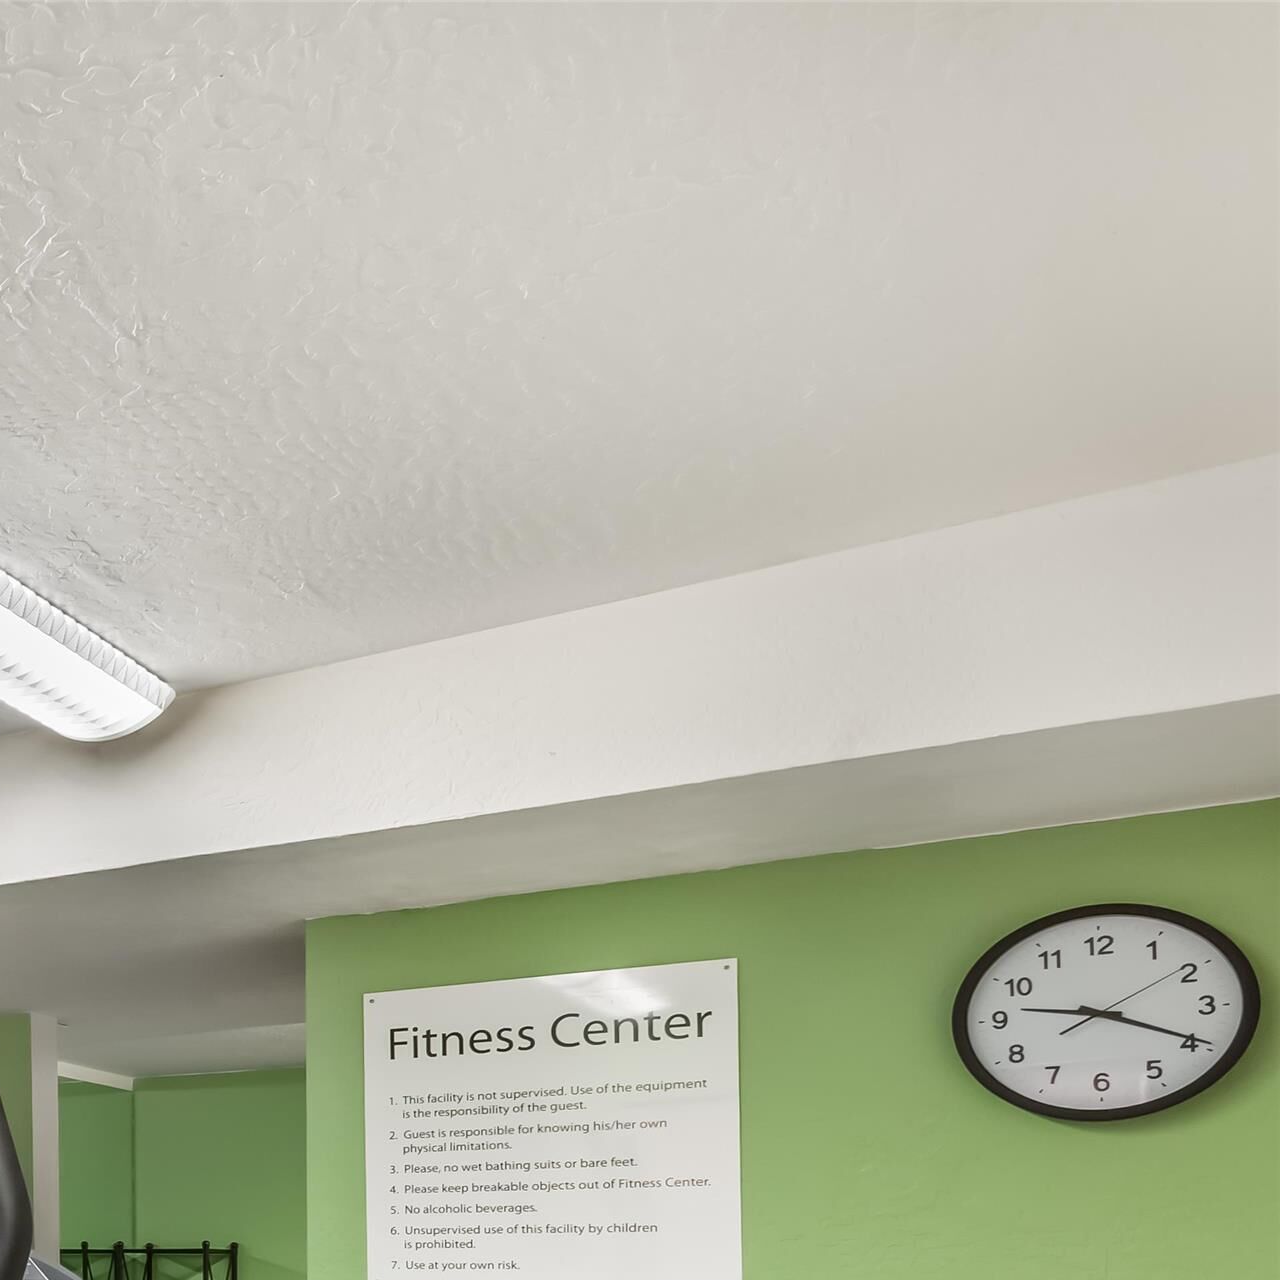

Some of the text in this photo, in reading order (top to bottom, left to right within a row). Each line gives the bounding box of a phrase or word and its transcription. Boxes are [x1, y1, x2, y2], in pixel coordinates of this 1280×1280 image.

[1083, 935, 1114, 956] 12
[1146, 940, 1157, 960] 1
[1038, 950, 1062, 969] 11
[1180, 963, 1198, 983] 2
[1004, 977, 1033, 997] 10
[1198, 995, 1216, 1015] 3
[992, 1011, 1008, 1029] 9
[390, 1011, 712, 1060] Fitness Center
[1180, 1033, 1199, 1052] 4
[1008, 1044, 1025, 1063] 8
[1044, 1066, 1061, 1085] 7
[1146, 1060, 1163, 1079] 5
[1093, 1072, 1110, 1091] 6
[389, 1079, 707, 1105] 1. This facility is not supervised. Use of the equipment
[402, 1102, 587, 1119] is the responsibility of the guest.
[403, 1129, 435, 1139] Guest
[438, 1129, 446, 1138] is
[449, 1125, 515, 1138] responsible
[517, 1124, 534, 1134] for
[537, 1122, 590, 1134] knowing
[593, 1120, 636, 1131] his/her
[639, 1120, 667, 1128] own
[402, 1141, 512, 1155] physical limitations.
[389, 1157, 638, 1175] 3. Please, no wet bathing suits or bare feet.
[389, 1176, 711, 1194] 4. Please keep breakable objects out of Fitness Center.
[390, 1204, 537, 1215] 5. No alcoholic beverages.
[390, 1222, 658, 1237] 6. Unsupervised use of this facility by children
[404, 1239, 476, 1250] is prohibited.
[391, 1260, 520, 1271] 7. Use at your own risk.
